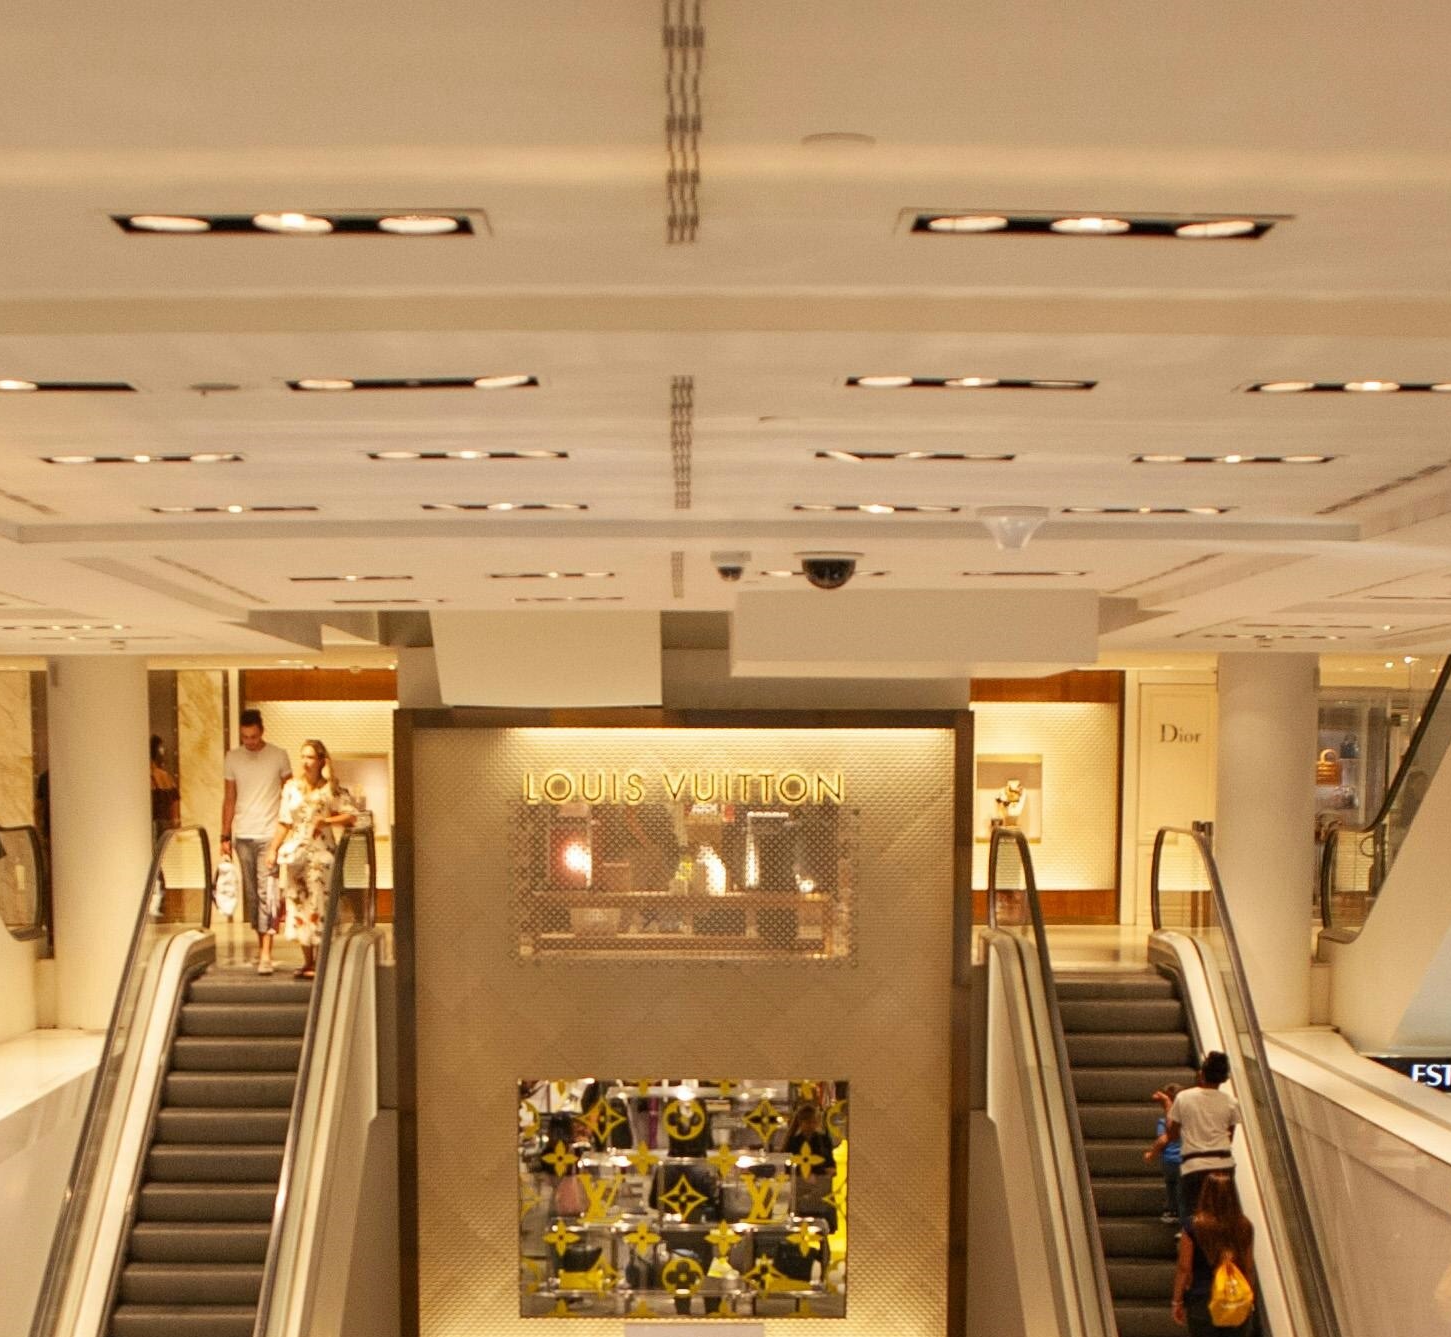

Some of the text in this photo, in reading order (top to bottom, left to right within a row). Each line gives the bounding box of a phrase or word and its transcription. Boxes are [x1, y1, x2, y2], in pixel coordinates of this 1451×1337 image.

[1160, 723, 1201, 744] Dior
[522, 772, 845, 802] LOUIS VUITTON
